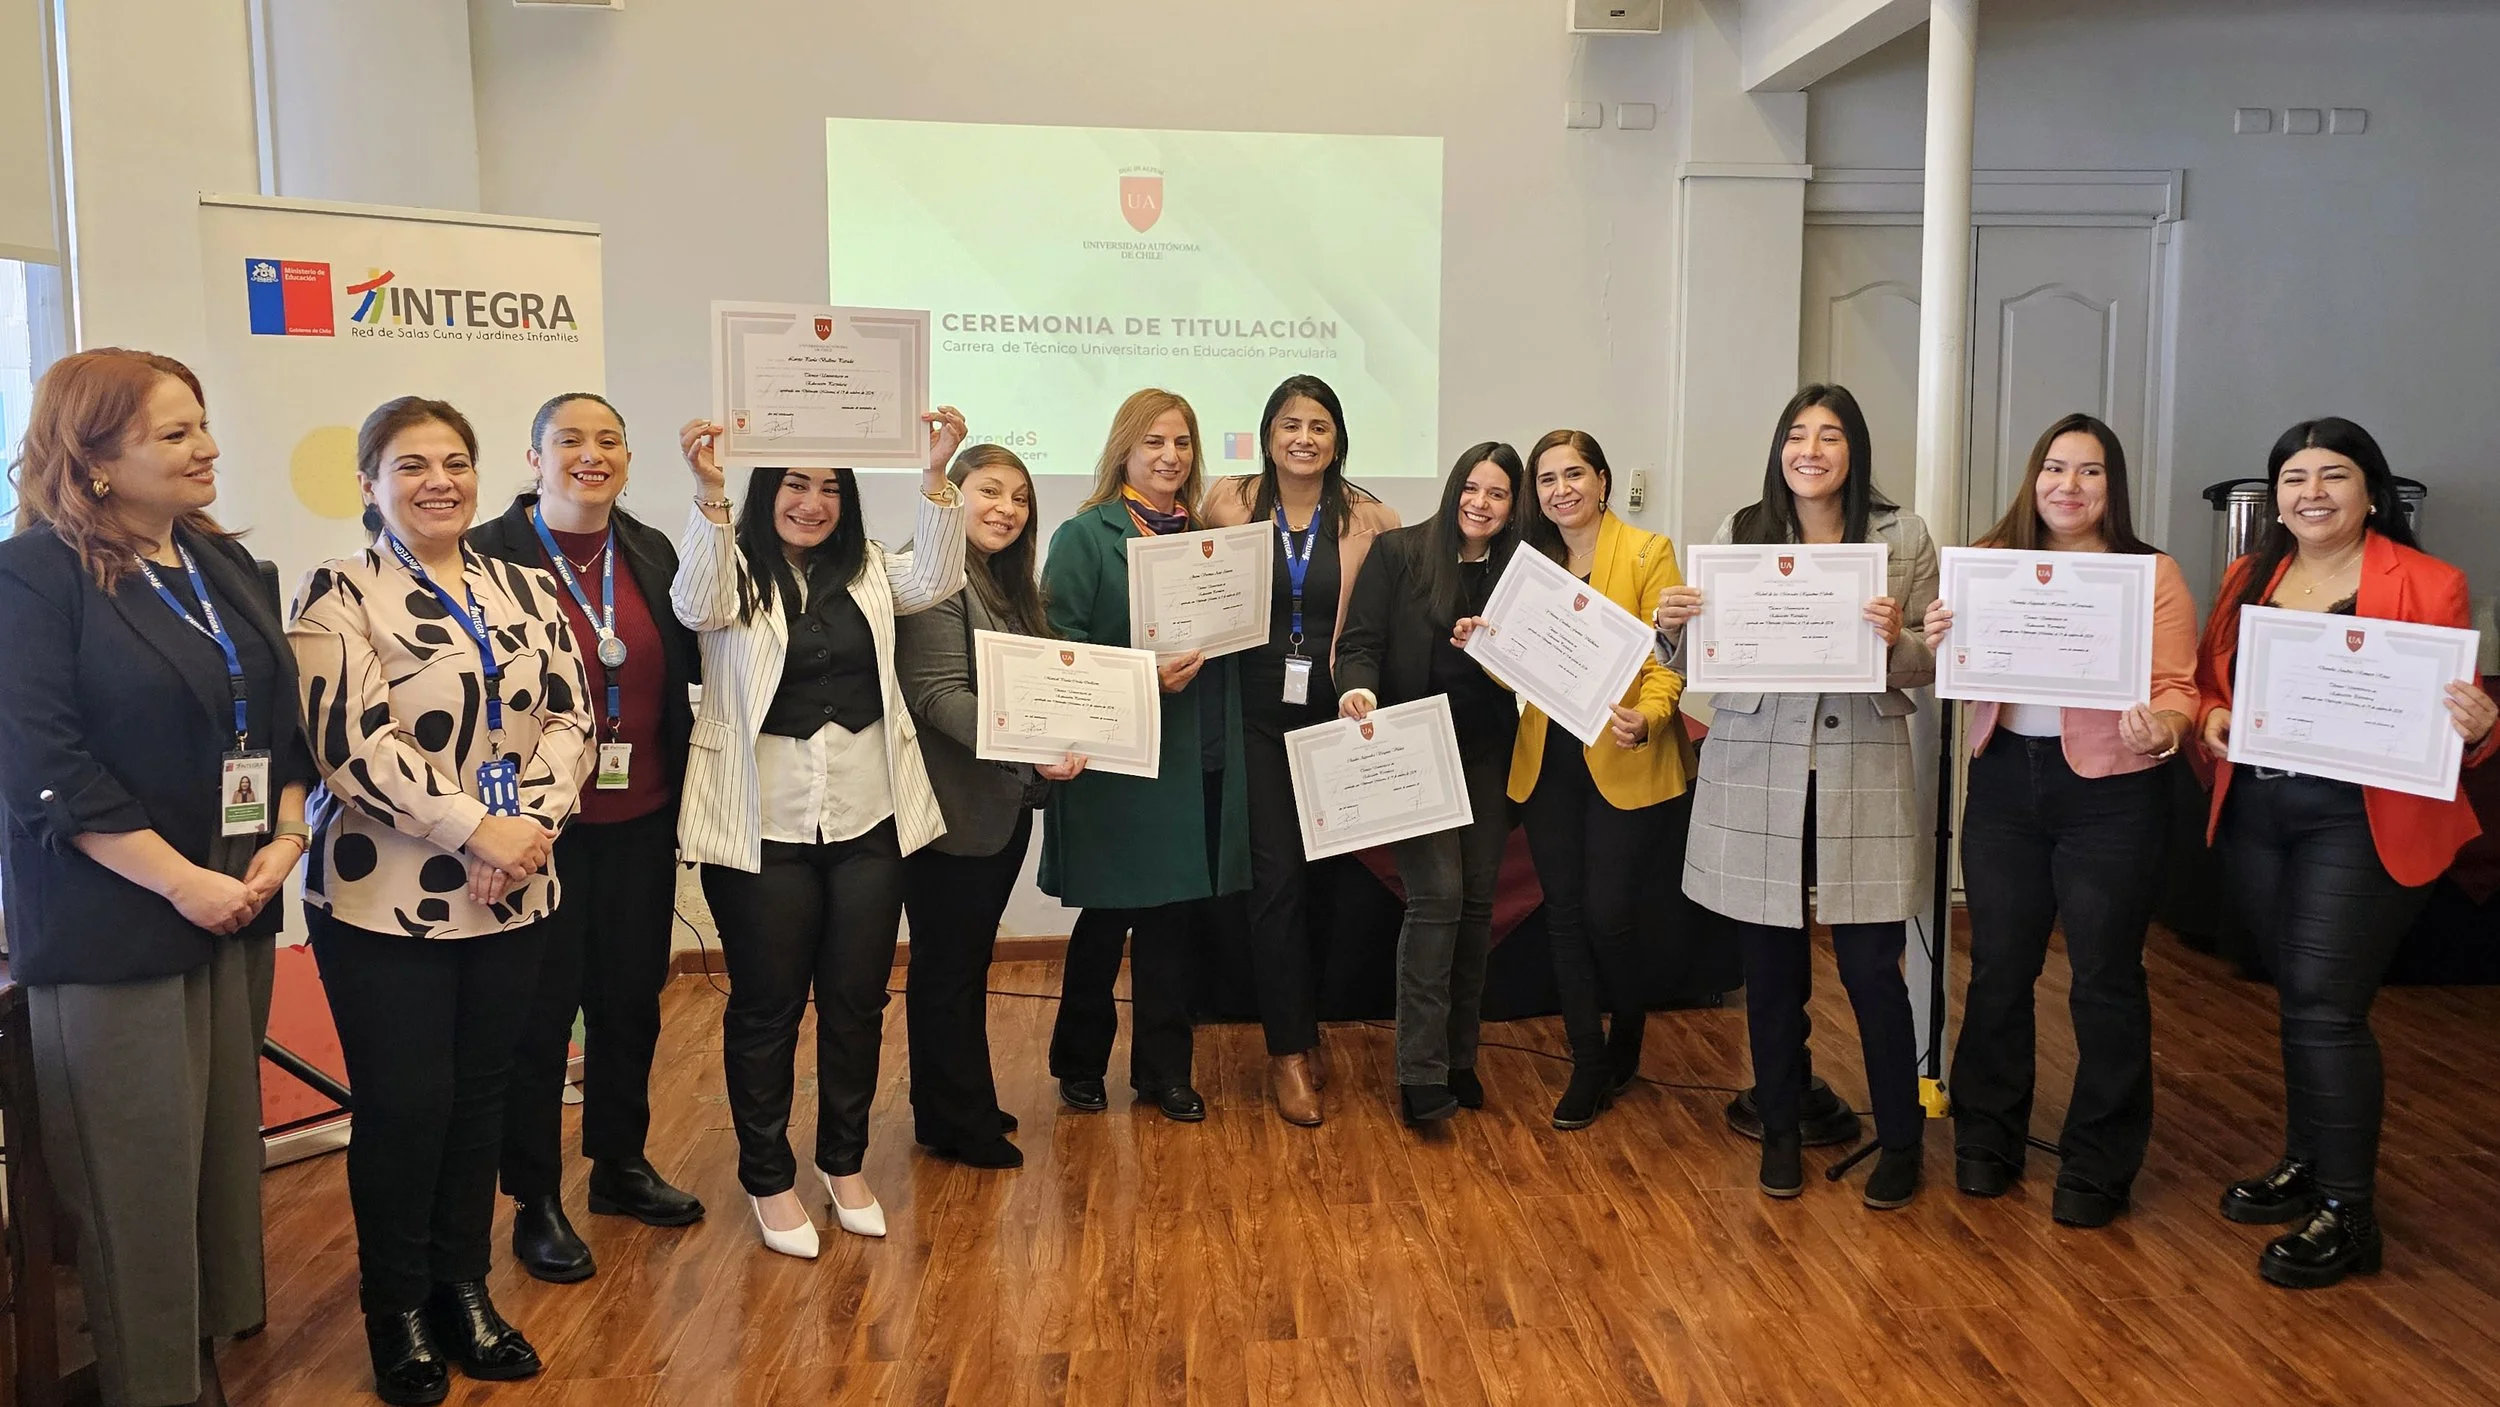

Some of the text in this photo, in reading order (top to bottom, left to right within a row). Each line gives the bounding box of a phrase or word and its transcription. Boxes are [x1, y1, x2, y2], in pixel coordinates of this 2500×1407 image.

[1127, 193, 1156, 209] UA
[1082, 240, 1201, 252] UNIVERSIDAD AUTÓNOMA
[1121, 251, 1163, 260] DE CHILE
[284, 267, 316, 275] Ministerio
[285, 274, 316, 282] Educación
[391, 287, 579, 331] INTEGRA
[817, 324, 830, 332] UA
[942, 313, 1337, 339] CEREMONIA DE TITULACIÓN
[352, 327, 579, 343] Red de Salas Cuna y Jardines Infantiles
[942, 340, 1337, 359] Carrera de Técnico Universitario en Educación Parvularia
[393, 540, 420, 571] INTEGRA
[553, 556, 574, 586] INTEGRA
[1780, 561, 1792, 569] UA
[2038, 569, 2051, 577] UA
[203, 602, 221, 634] INTEGRA
[470, 608, 486, 639] INTEGRA
[2347, 636, 2362, 644] UA
[1361, 728, 1373, 736] UA
